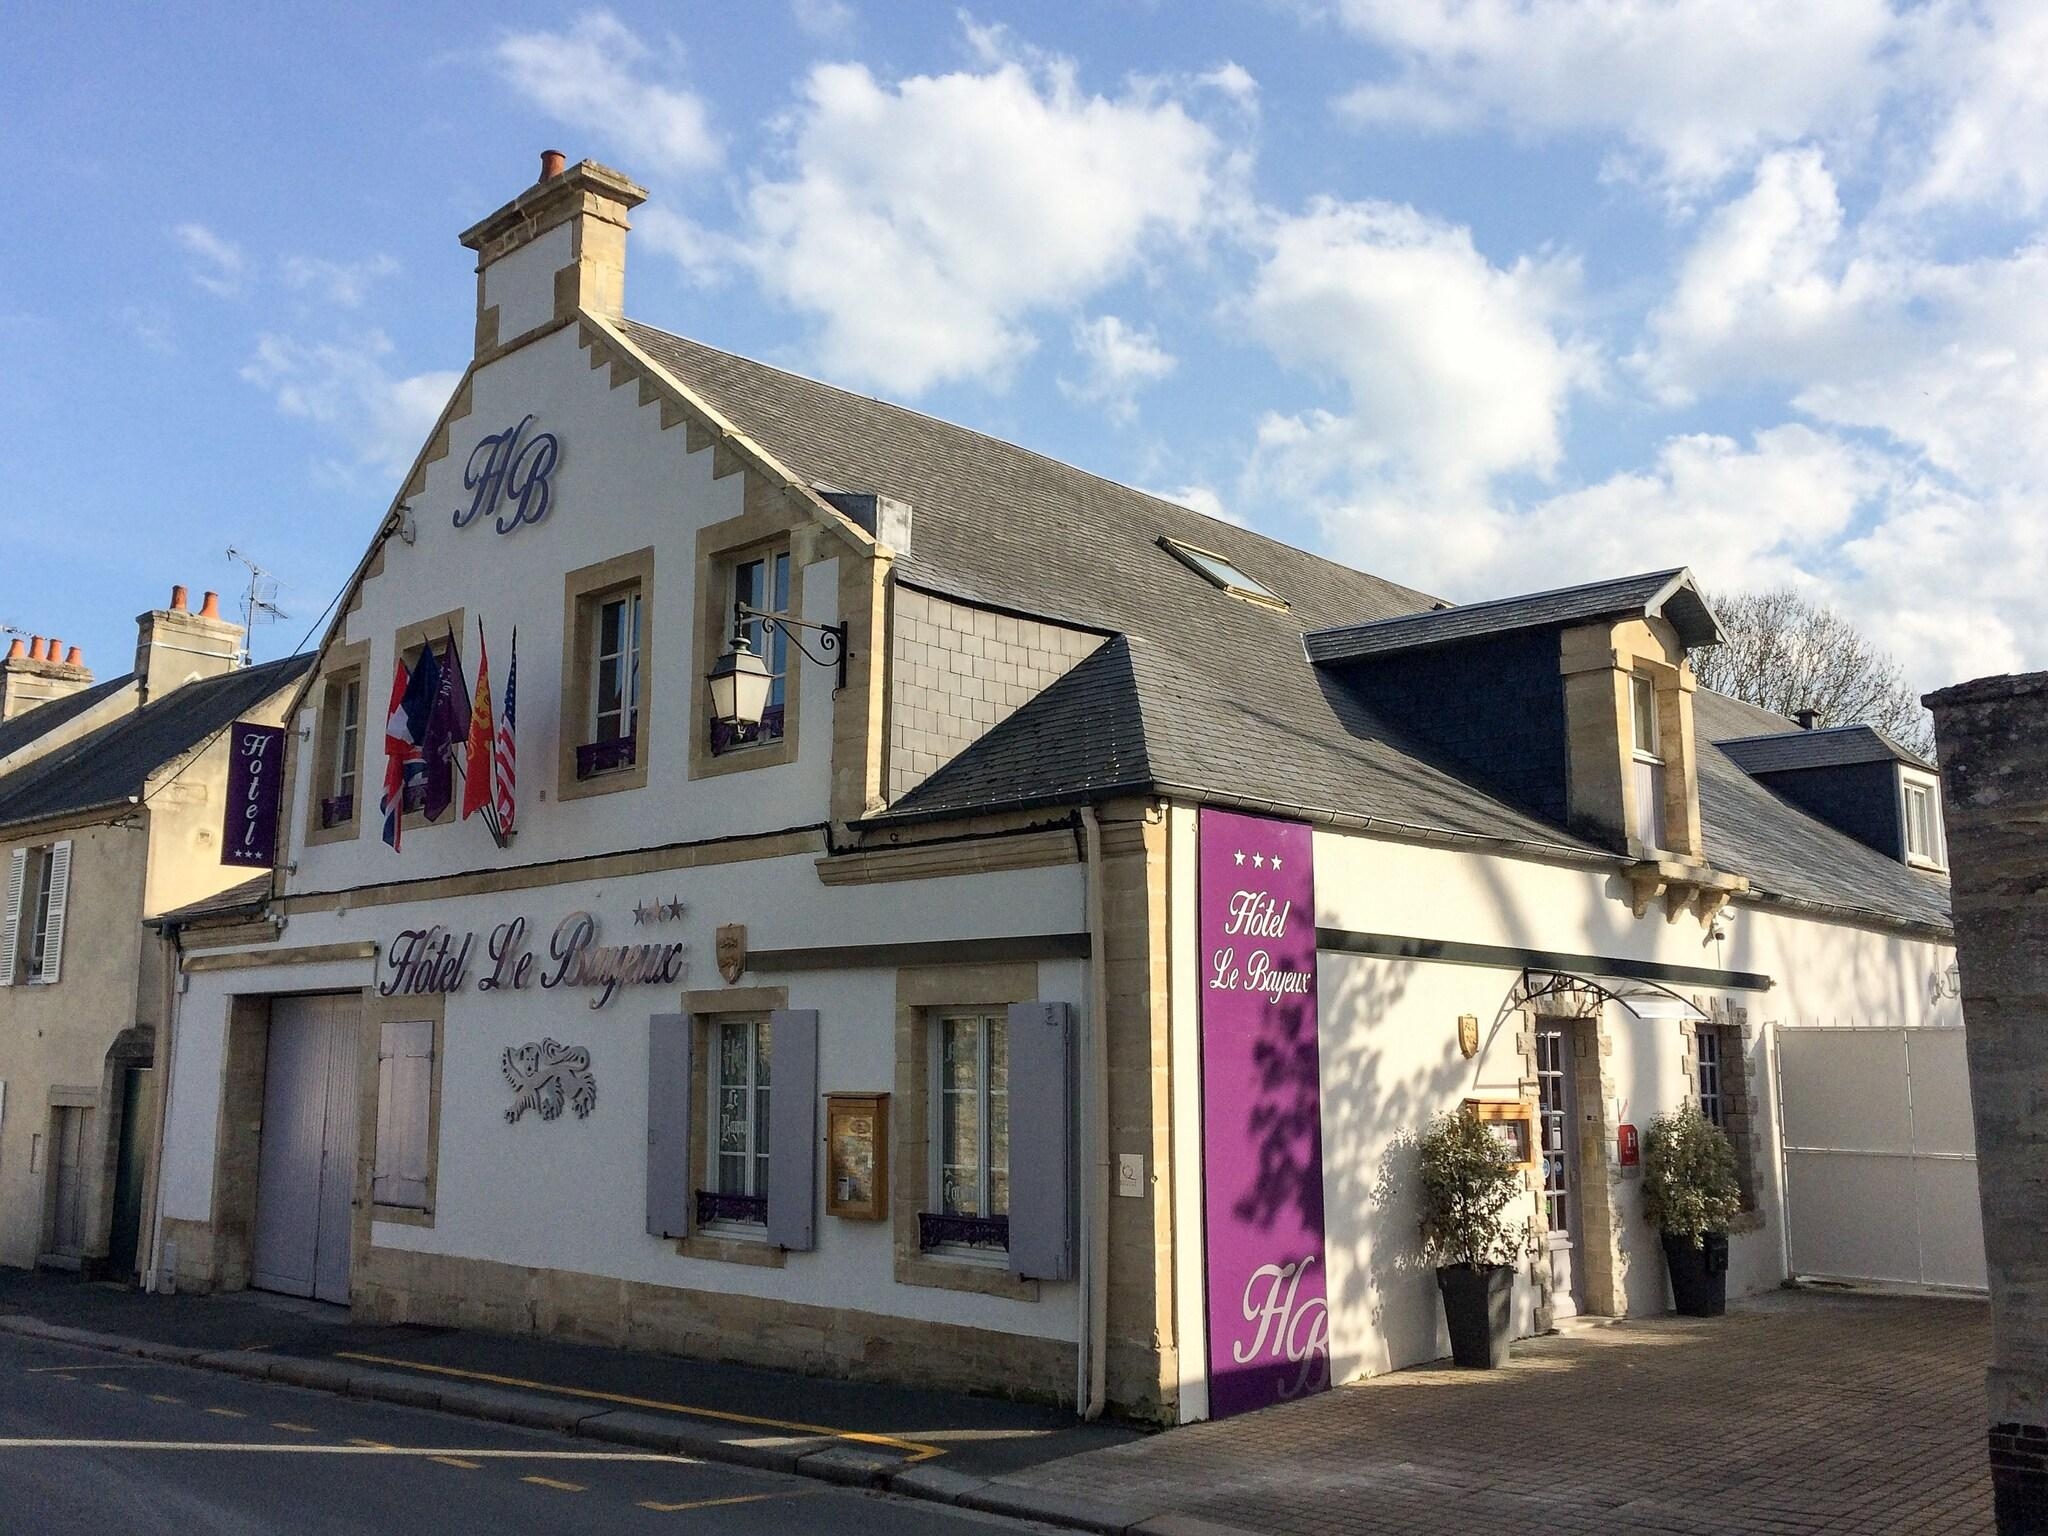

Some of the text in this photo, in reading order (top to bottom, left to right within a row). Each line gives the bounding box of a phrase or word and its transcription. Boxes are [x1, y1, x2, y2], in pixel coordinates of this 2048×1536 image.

[453, 414, 558, 534] HB
[241, 733, 274, 846] Hotel
[380, 910, 684, 1010] Hôtel Le Bayeux
[1225, 890, 1291, 939] Hôtel
[1209, 947, 1312, 1004] Le Bayeux
[1233, 1255, 1330, 1398] HB
